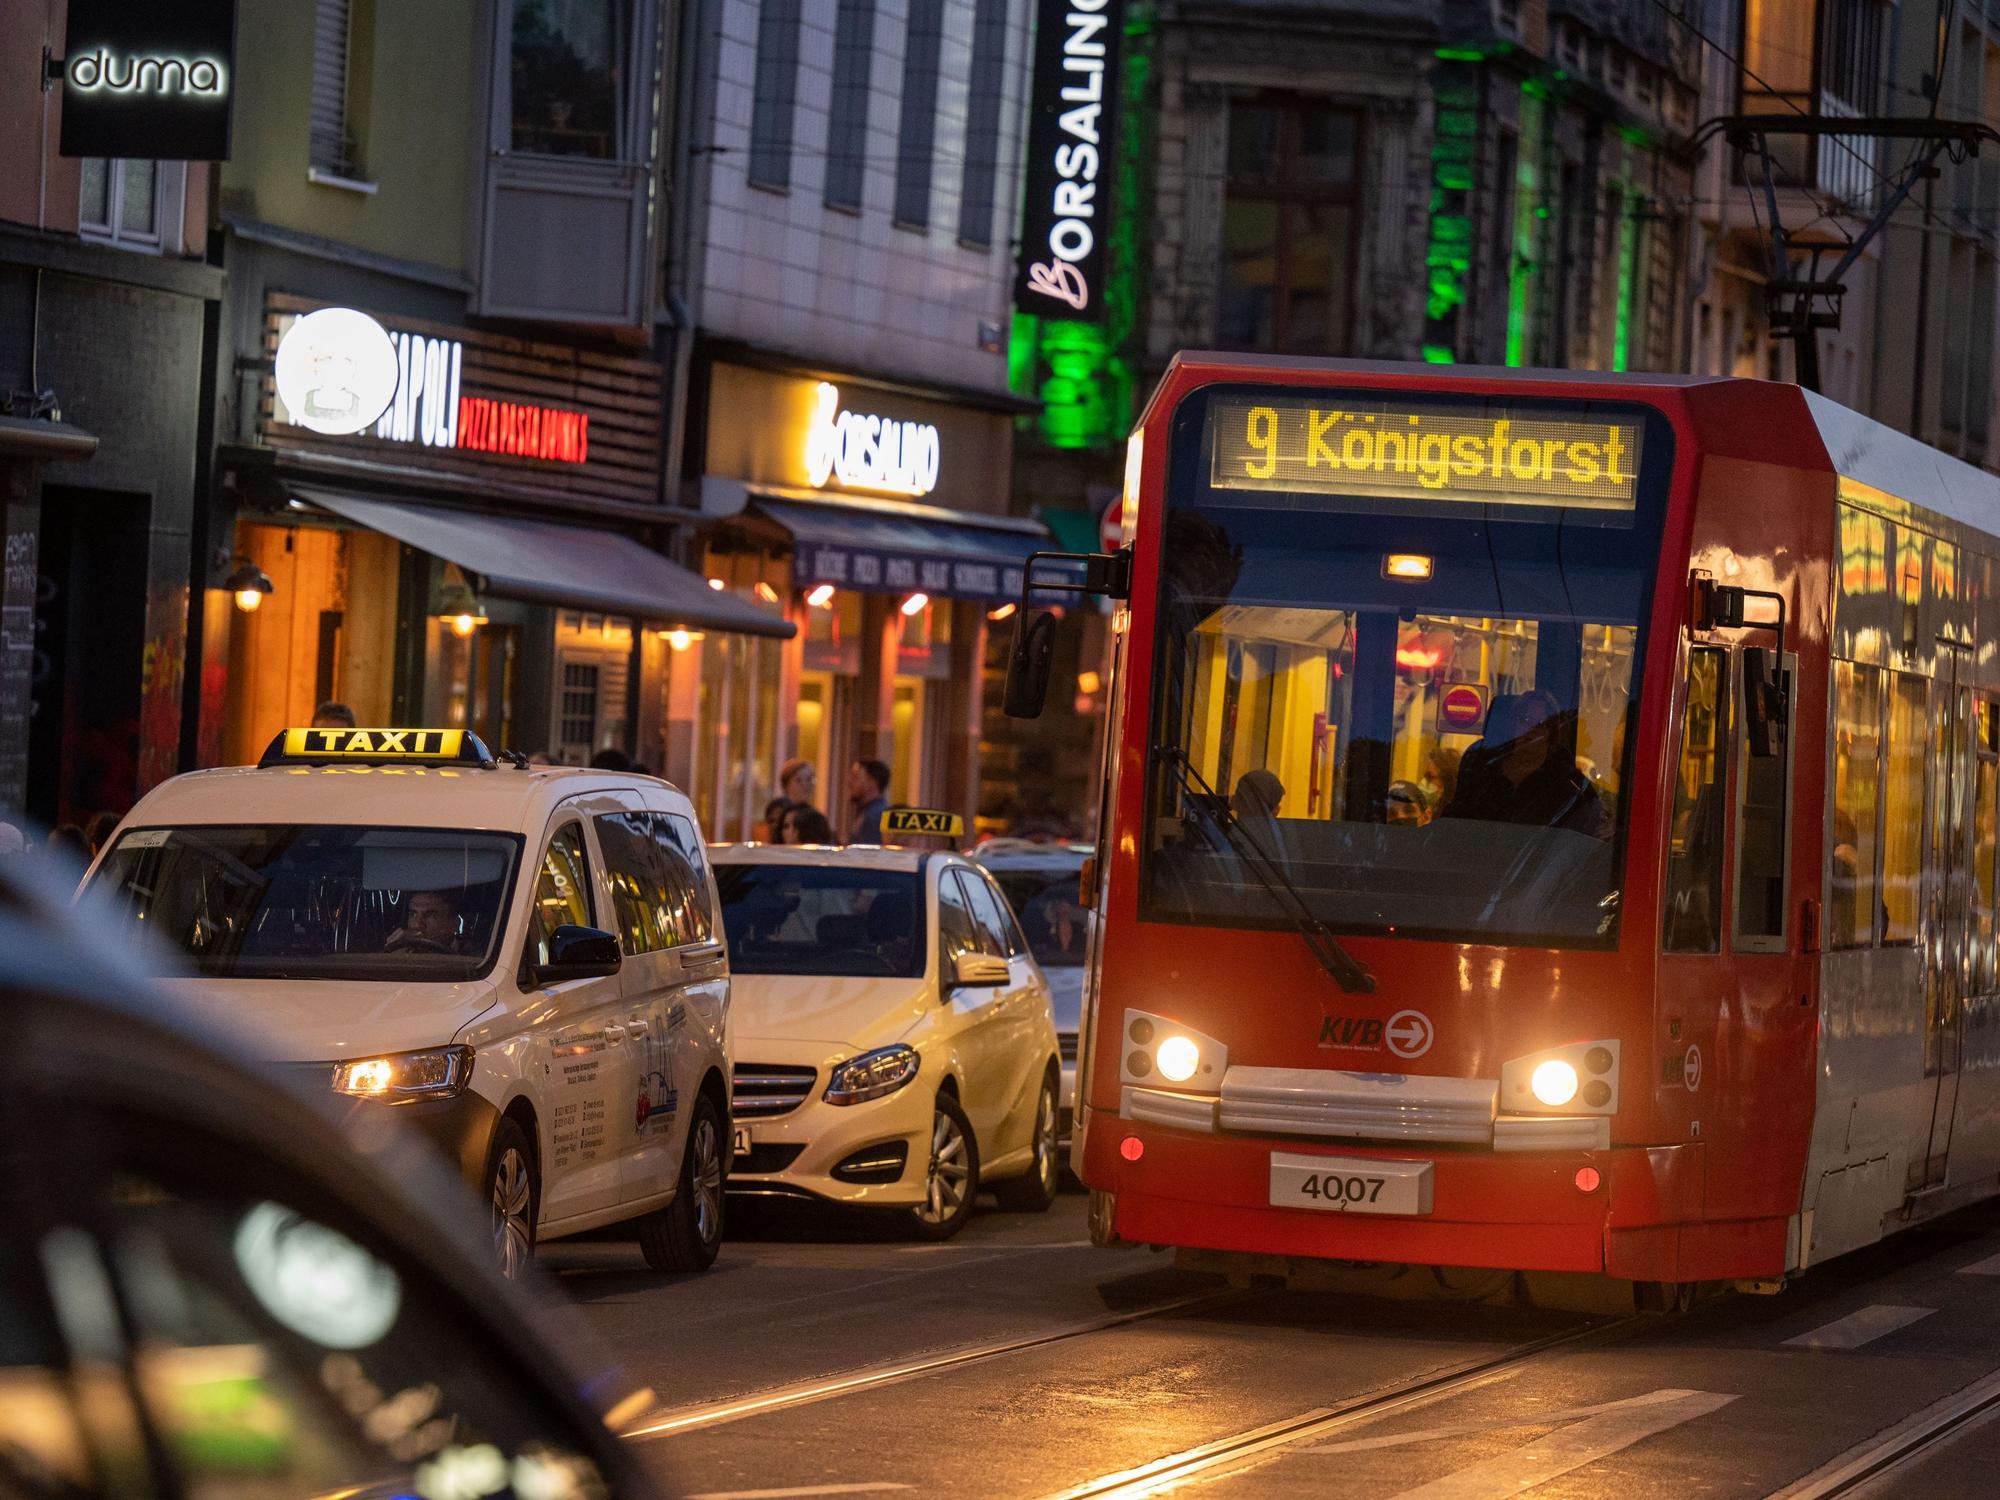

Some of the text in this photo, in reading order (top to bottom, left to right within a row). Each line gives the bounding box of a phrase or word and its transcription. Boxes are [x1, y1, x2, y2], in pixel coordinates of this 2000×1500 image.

[69, 48, 222, 93] duma
[457, 396, 498, 452] PIZZA
[499, 401, 540, 458] PASTA
[1246, 406, 1626, 489] 9 Königsforst
[318, 731, 428, 753] TAXI
[895, 812, 948, 831] TAXI
[1319, 1015, 1383, 1045] KVB
[1301, 1174, 1385, 1203] 4007
